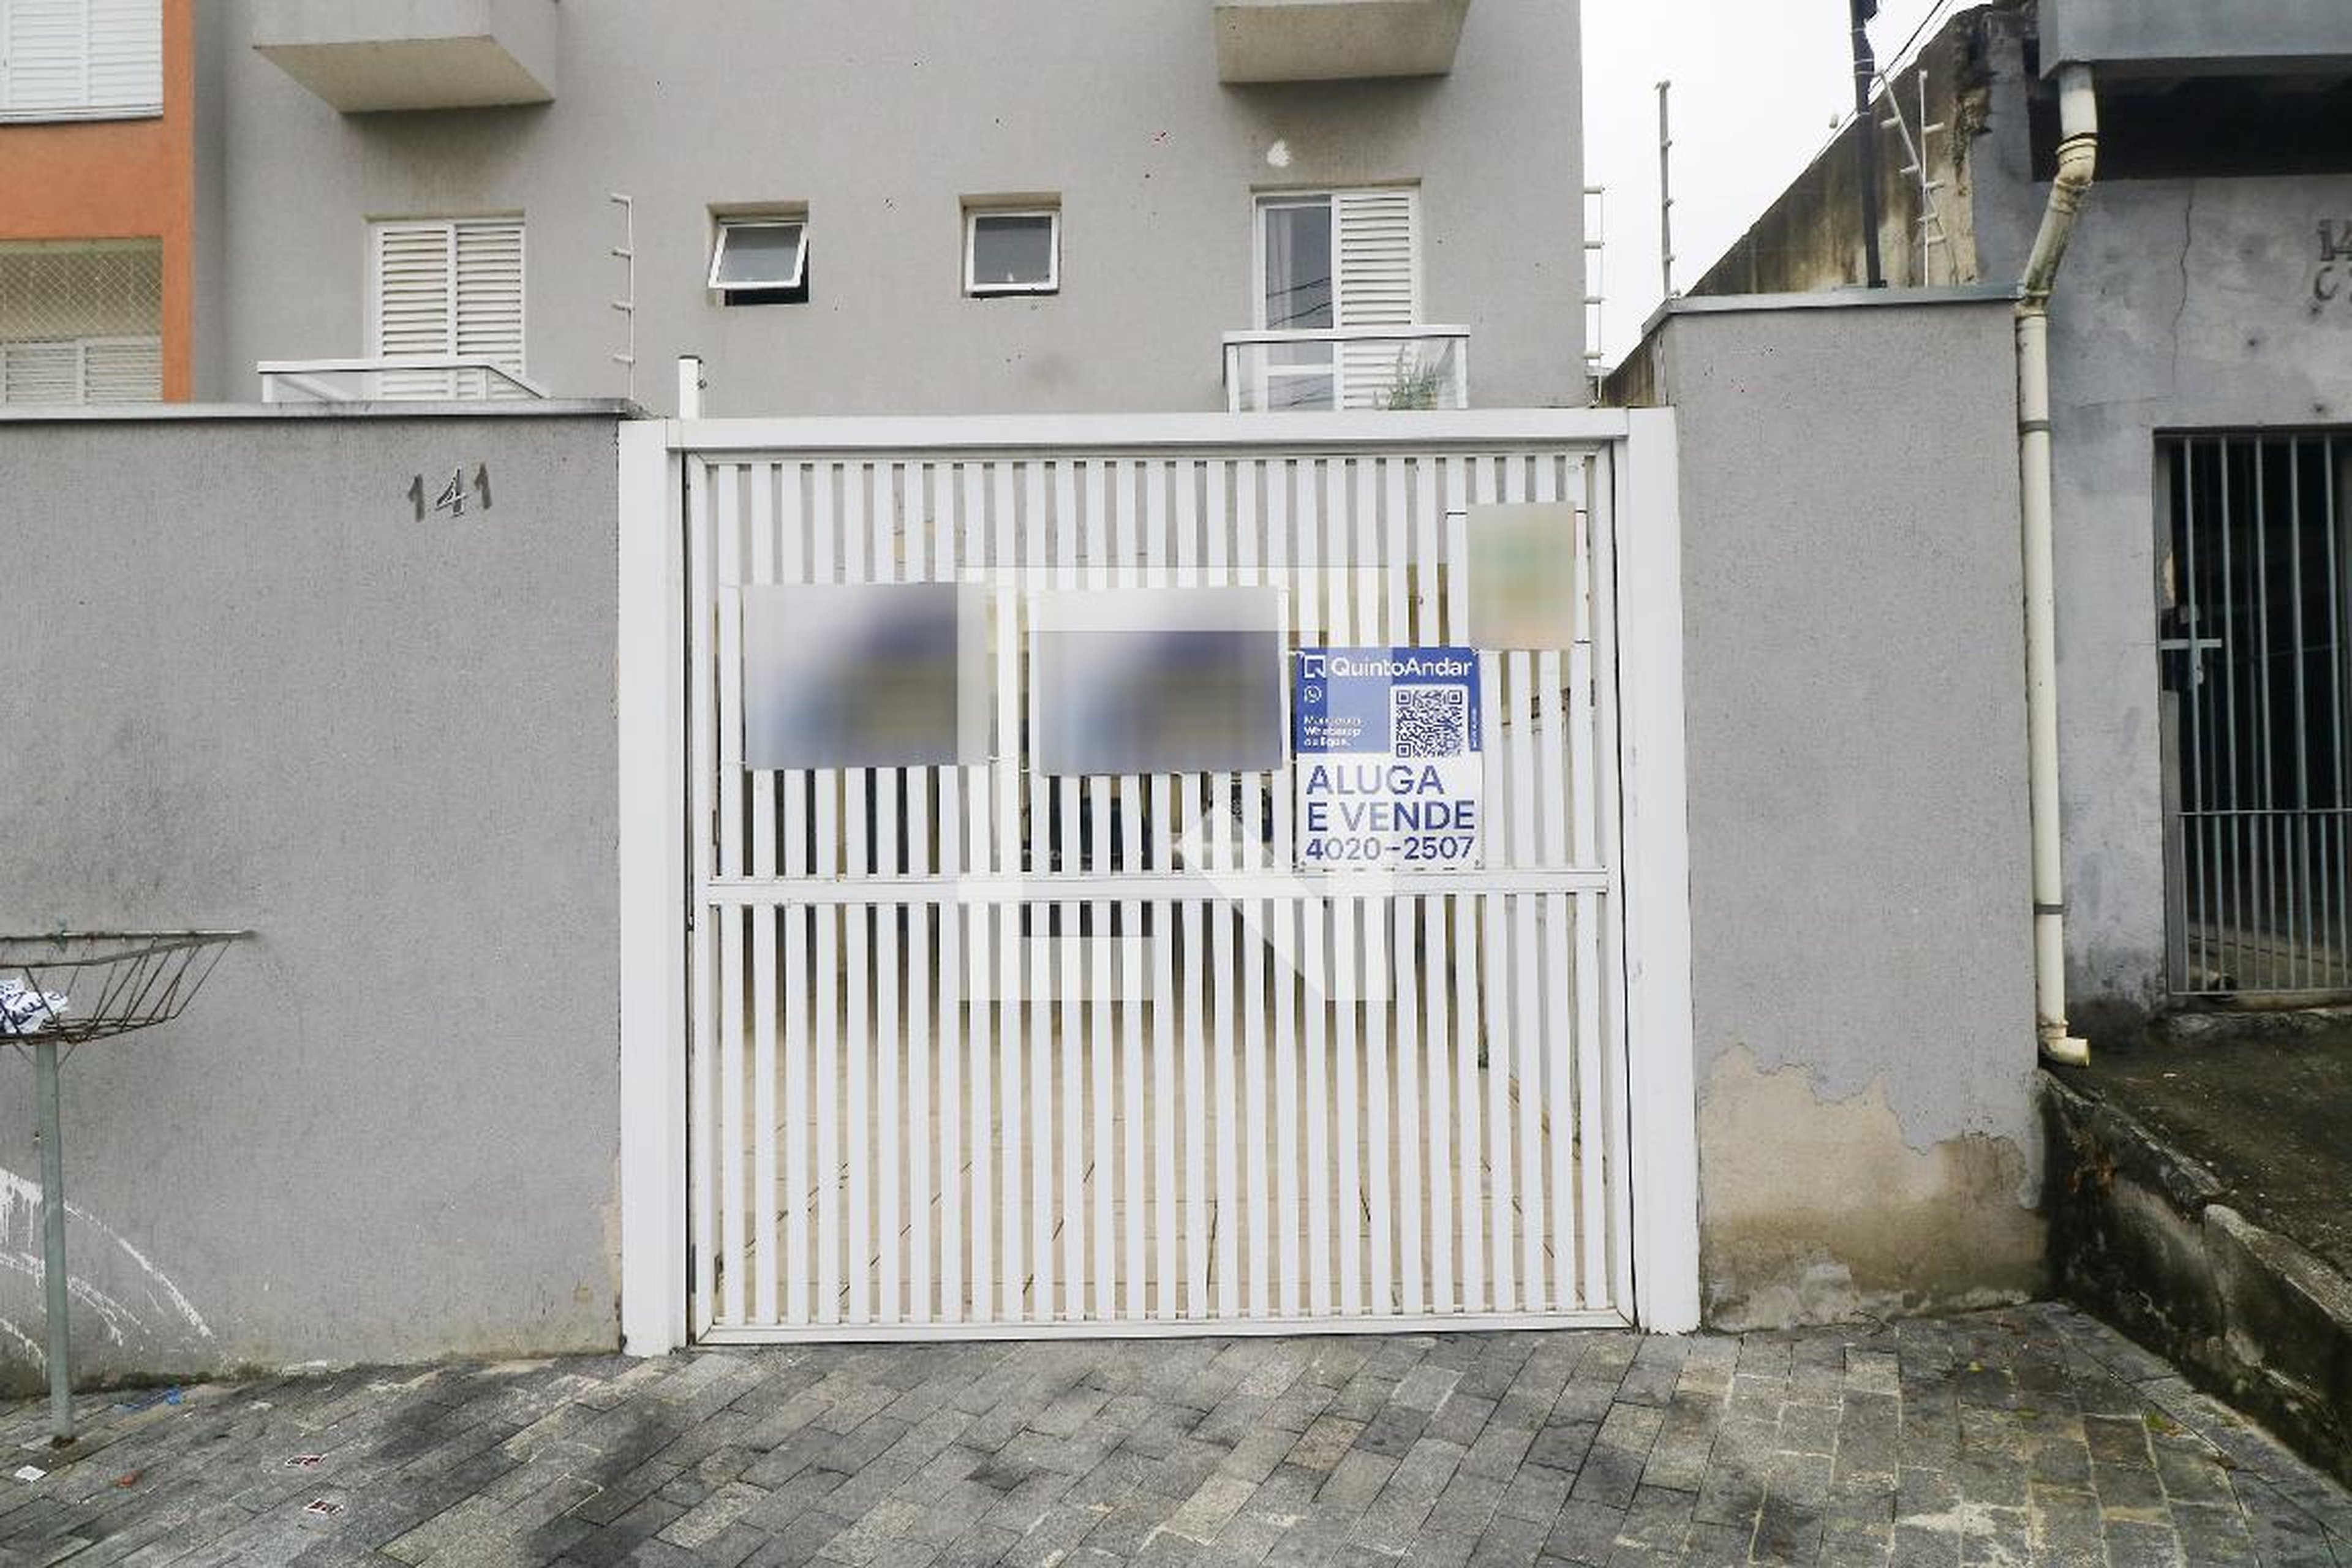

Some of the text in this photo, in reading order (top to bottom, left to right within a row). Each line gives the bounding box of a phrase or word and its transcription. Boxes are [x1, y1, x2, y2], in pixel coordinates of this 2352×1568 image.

[407, 462, 493, 523] 141
[1330, 657, 1472, 677] QuintoAndar
[1306, 765, 1444, 795] ALUGA
[1308, 801, 1474, 832] E VENDE
[1306, 837, 1474, 860] 4020-2507
